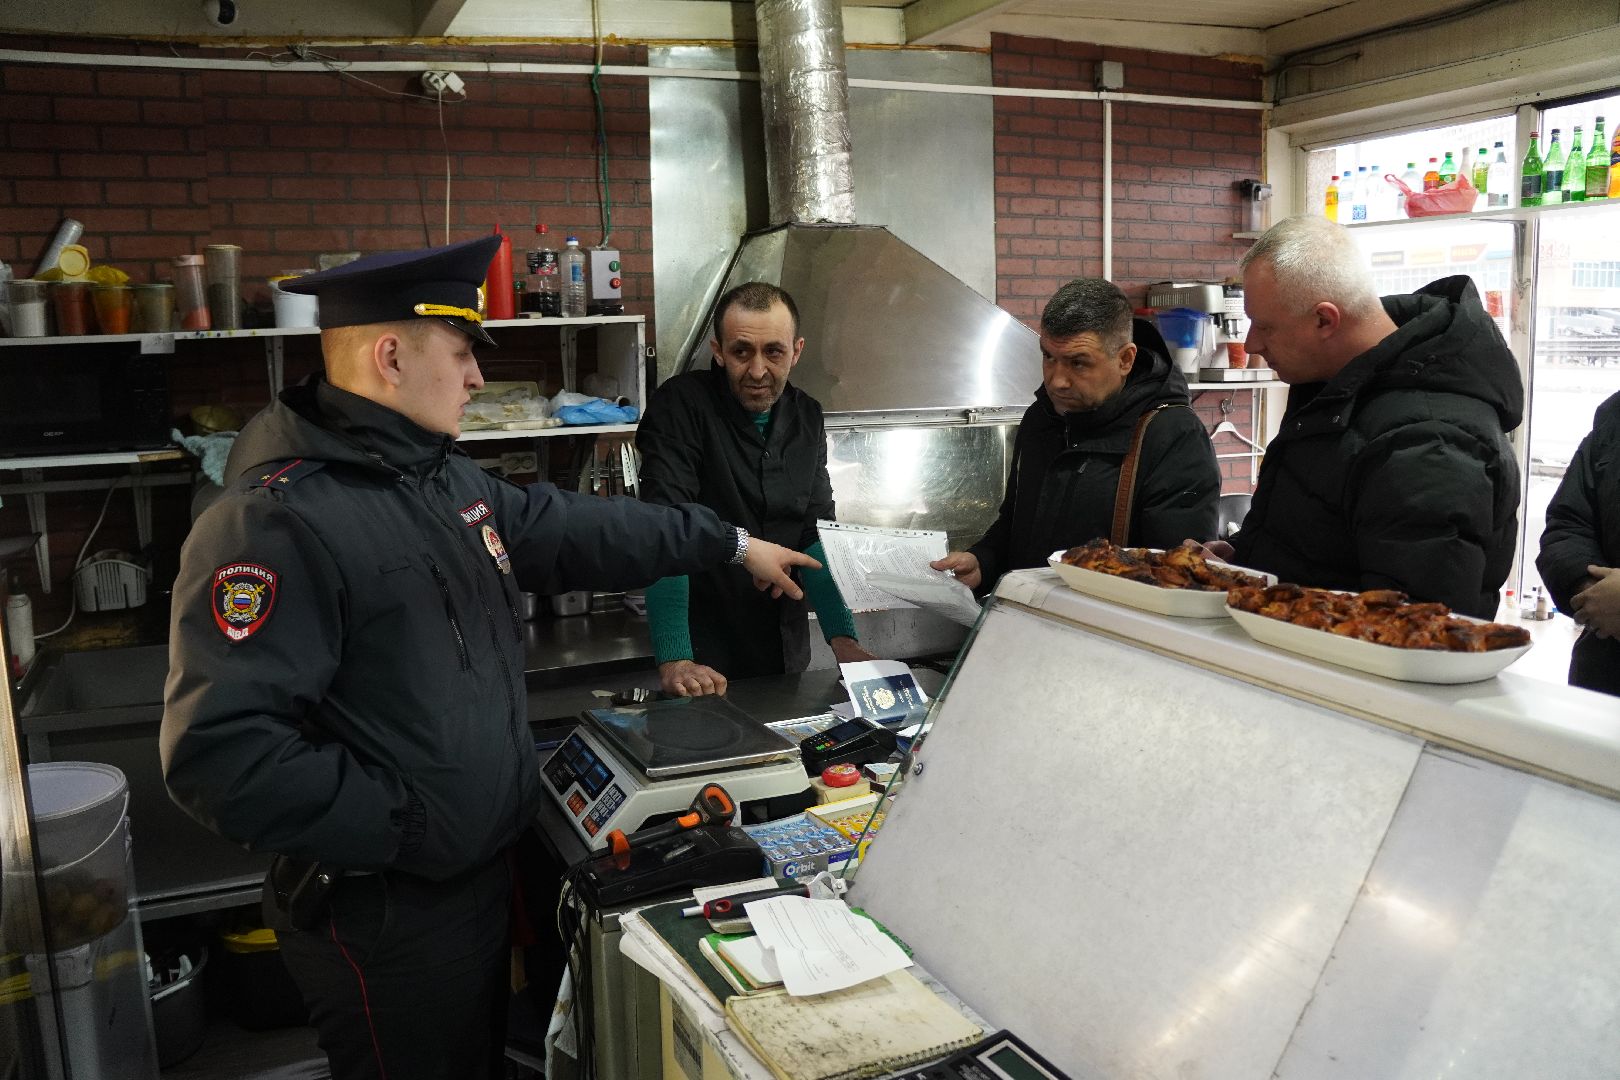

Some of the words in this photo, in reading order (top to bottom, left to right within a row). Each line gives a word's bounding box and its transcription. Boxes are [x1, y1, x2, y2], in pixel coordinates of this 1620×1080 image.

[218, 565, 274, 584] ПОЛИЦИЯ
[226, 626, 249, 640] МВД
[784, 861, 816, 878] Orbit
